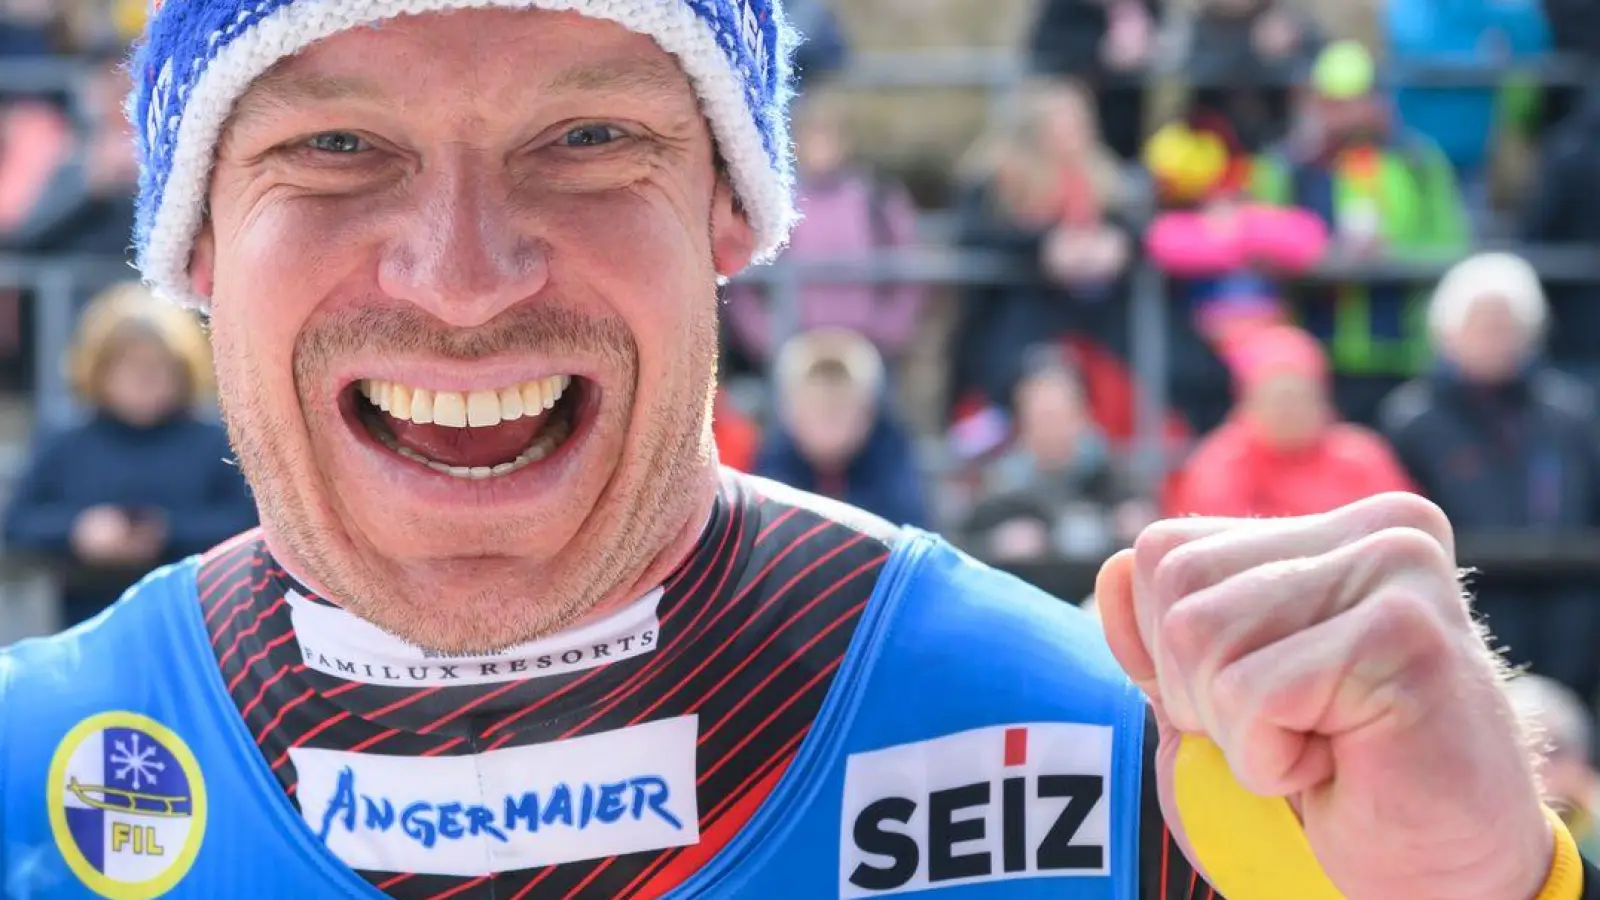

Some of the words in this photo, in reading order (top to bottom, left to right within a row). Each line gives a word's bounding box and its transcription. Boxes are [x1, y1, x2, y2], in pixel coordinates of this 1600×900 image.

[304, 646, 459, 681] FAMILUX
[479, 630, 654, 676] RESORTS
[318, 764, 684, 849] ANGERMAIER
[112, 821, 165, 856] FIL
